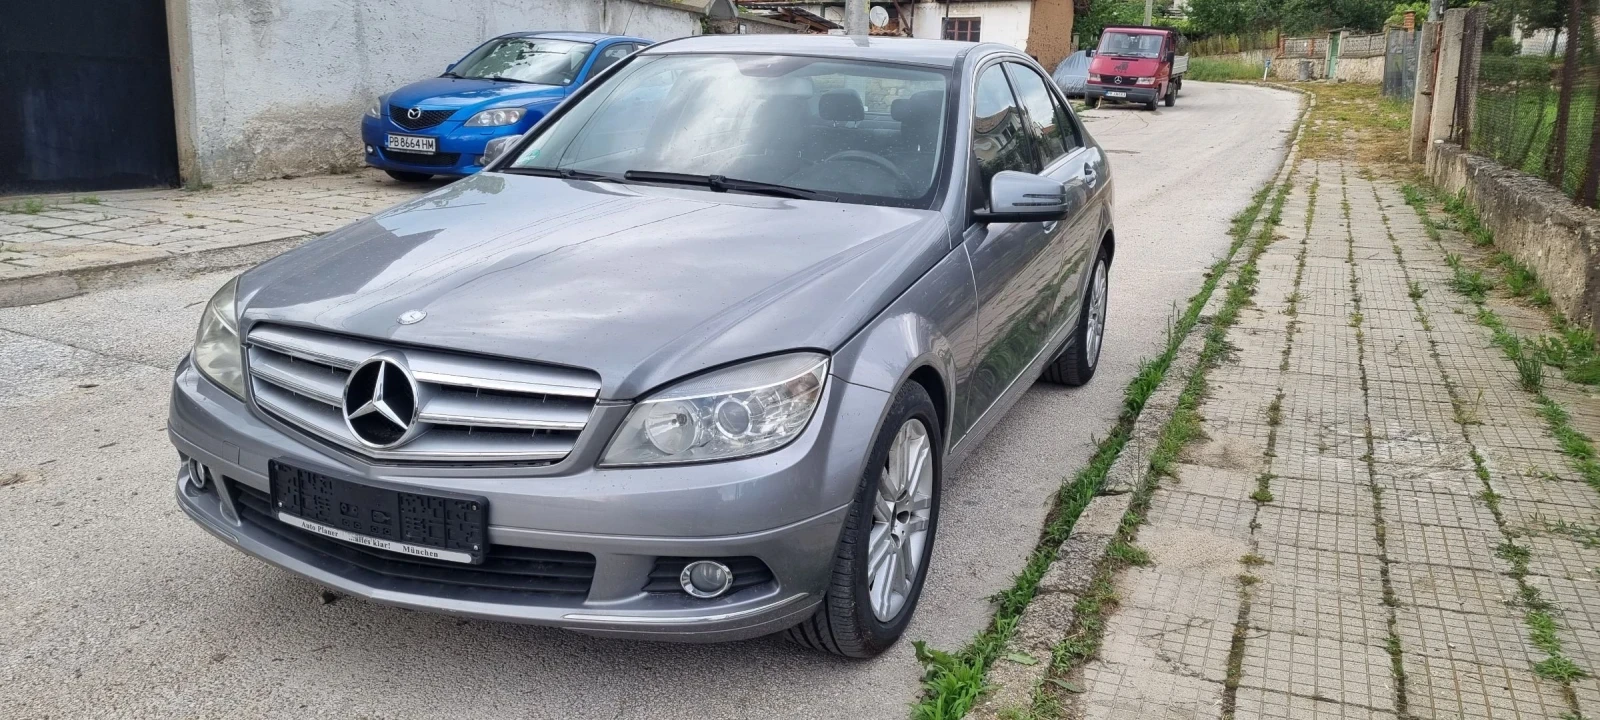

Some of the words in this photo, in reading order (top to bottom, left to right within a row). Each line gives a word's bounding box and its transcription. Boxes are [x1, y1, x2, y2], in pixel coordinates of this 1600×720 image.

[389, 137, 399, 147] PB
[400, 137, 420, 148] 8664
[422, 139, 434, 150] HM
[301, 521, 316, 531] Auto
[317, 525, 339, 537] Planer
[372, 539, 391, 550] klar!
[402, 545, 439, 558] München
